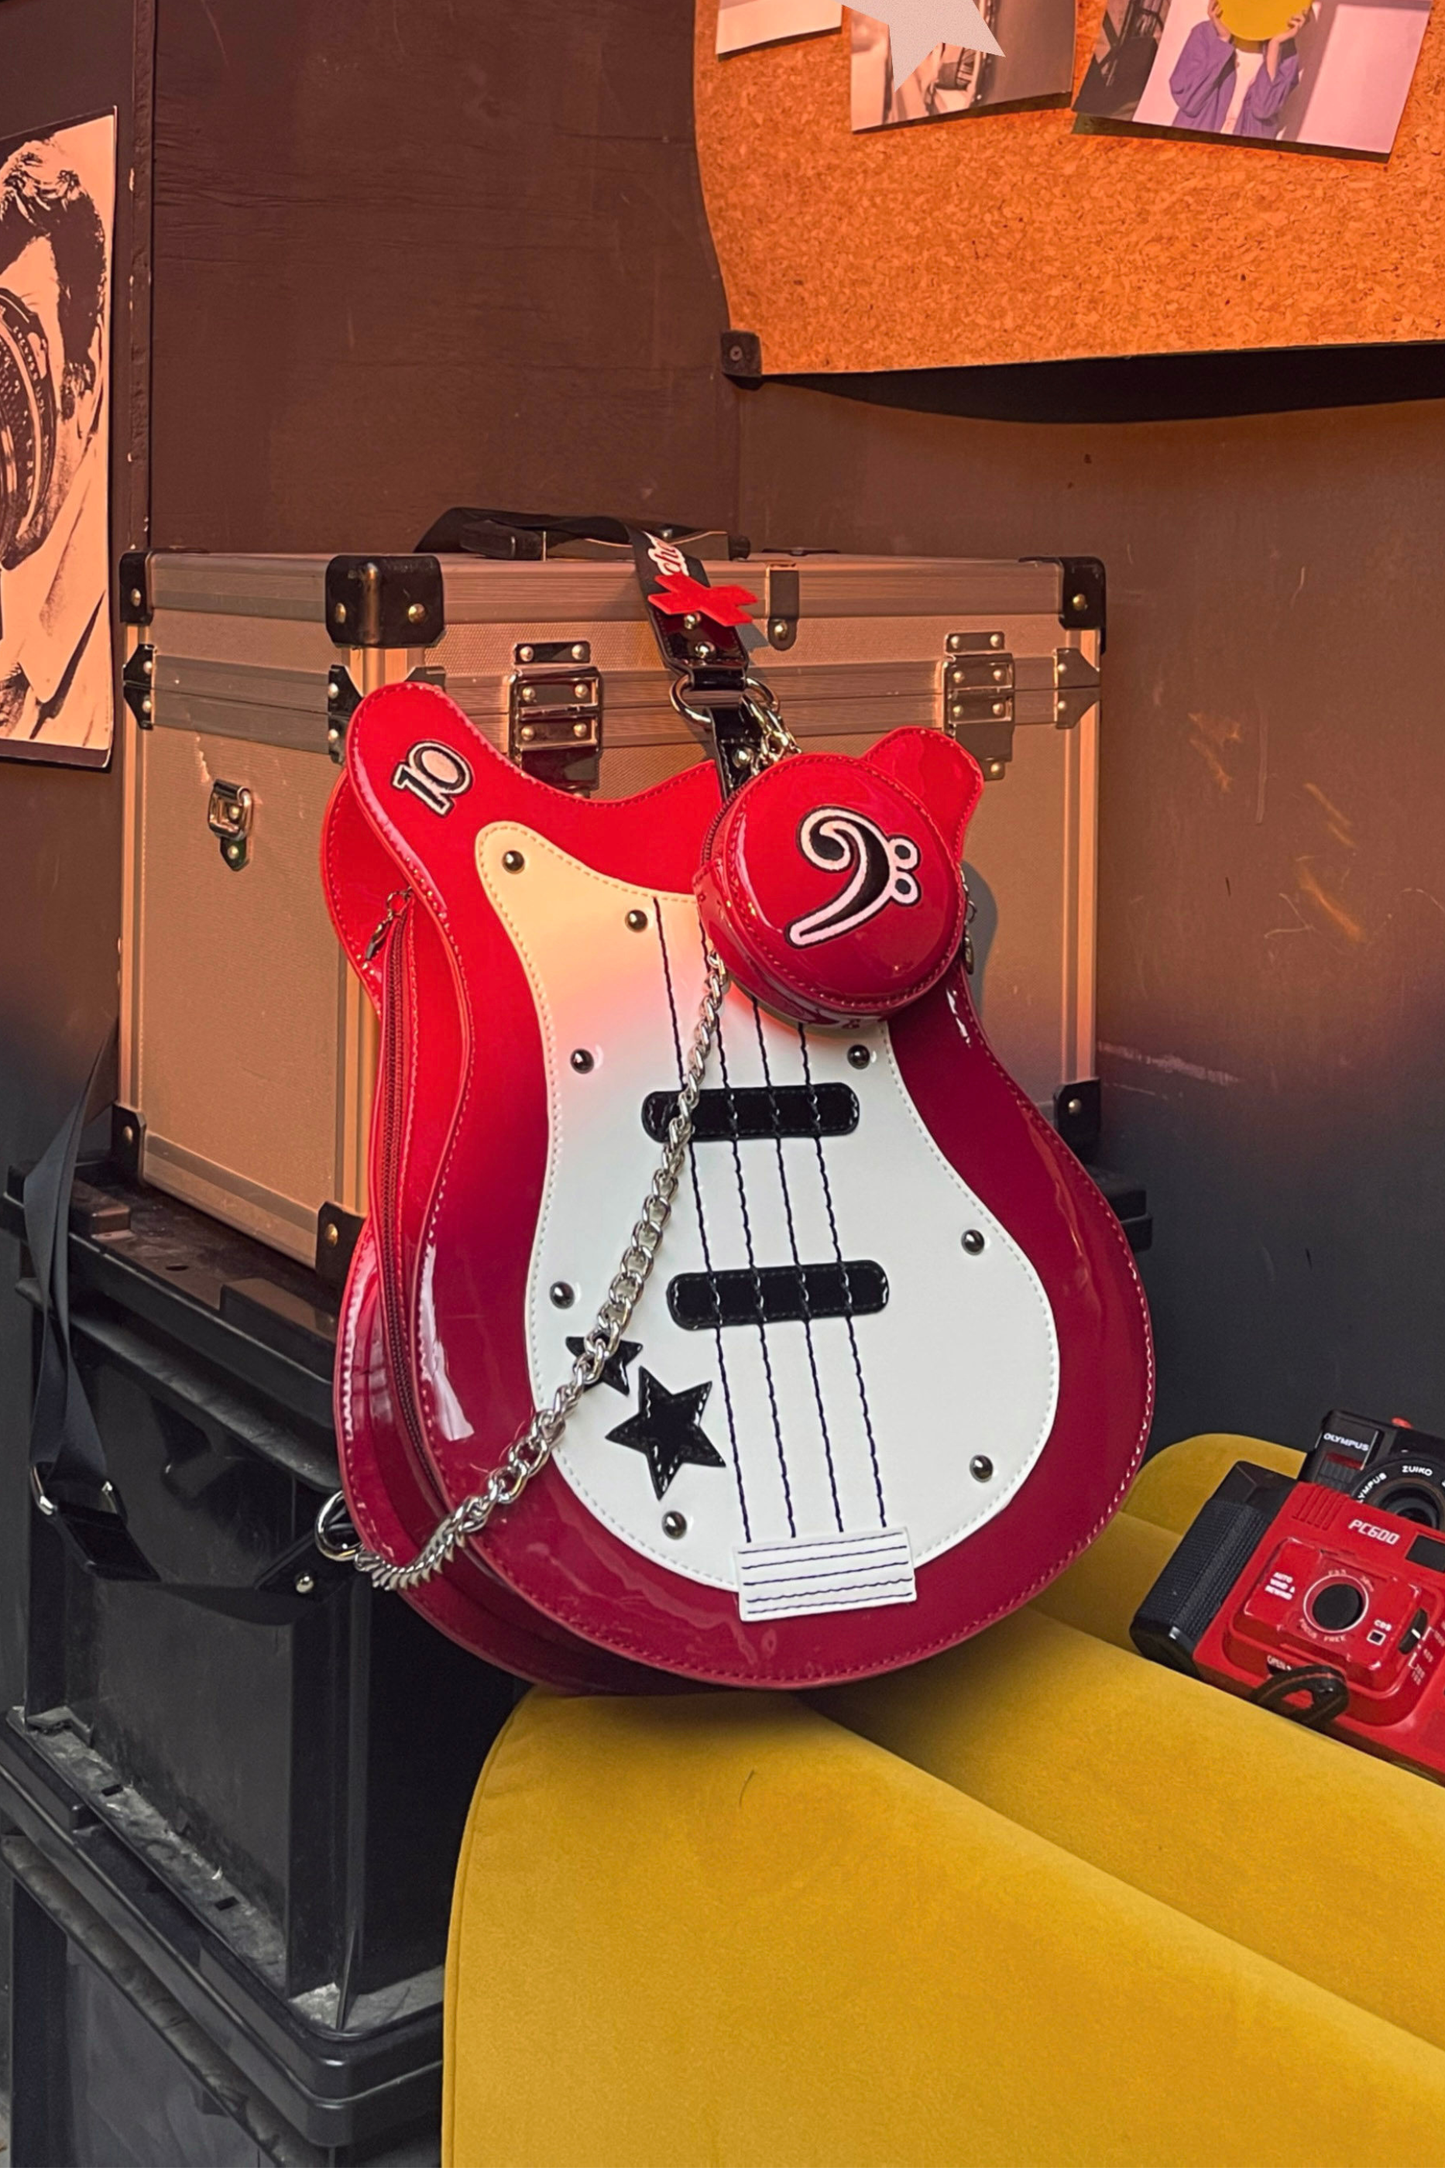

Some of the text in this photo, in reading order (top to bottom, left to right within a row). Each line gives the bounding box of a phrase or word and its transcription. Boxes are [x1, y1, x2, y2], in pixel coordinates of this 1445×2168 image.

[391, 740, 472, 816] 10
[1323, 1432, 1370, 1452] OLYMPUS
[1401, 1464, 1433, 1477] ZUIKO
[1348, 1518, 1400, 1545] PC600
